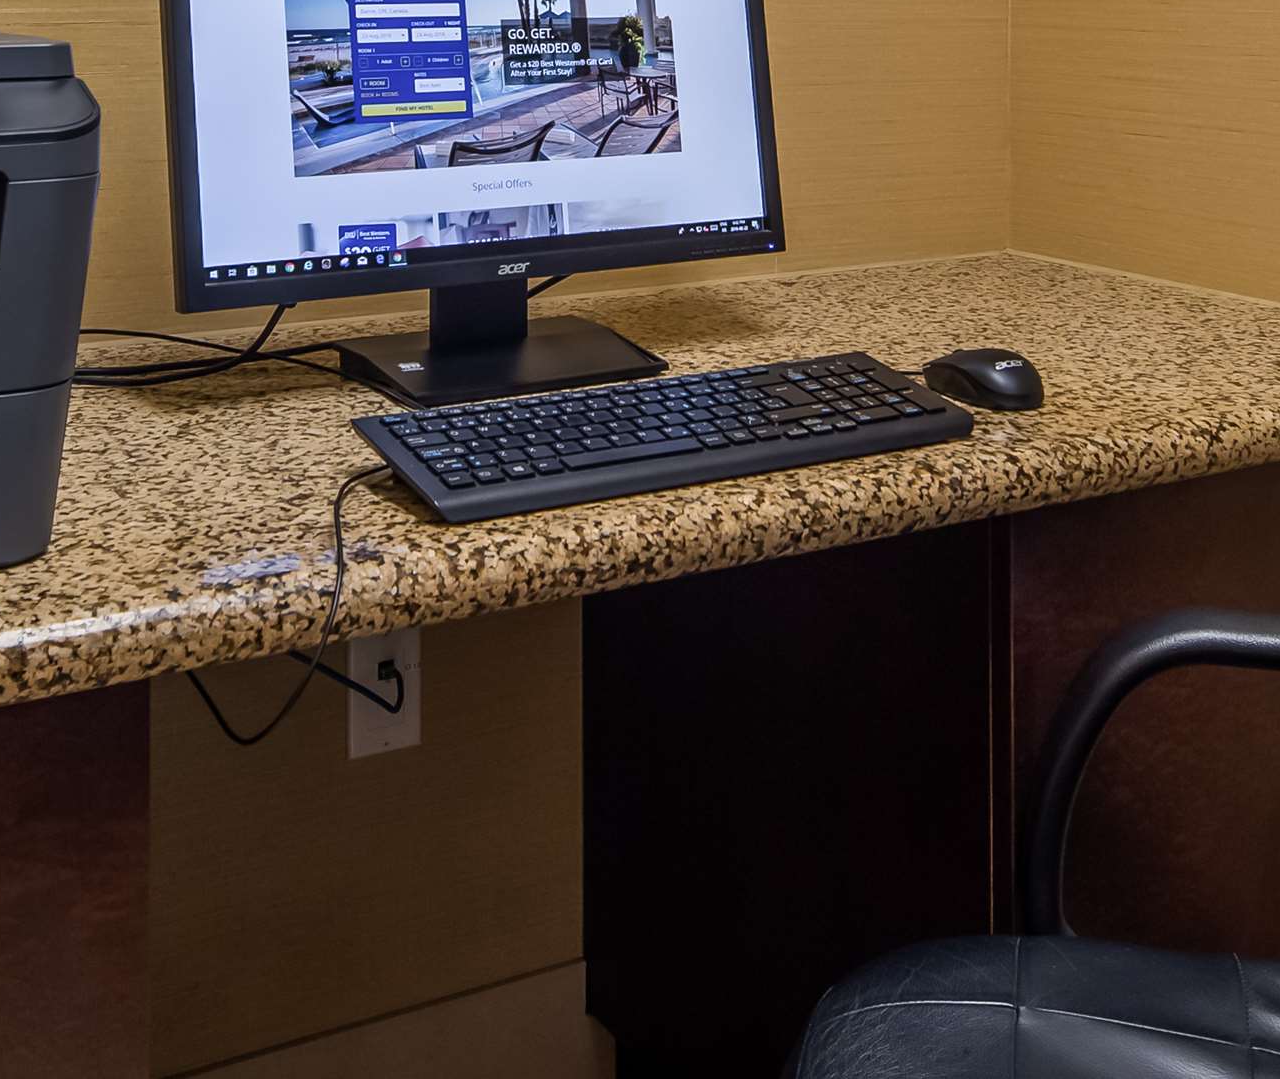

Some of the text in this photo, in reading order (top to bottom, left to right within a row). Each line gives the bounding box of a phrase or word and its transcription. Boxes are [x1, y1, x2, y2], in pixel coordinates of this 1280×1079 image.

[508, 28, 555, 40] GO. GET.
[472, 179, 532, 193] Special Offers
[498, 262, 530, 275] acer
[995, 360, 1023, 370] acer
